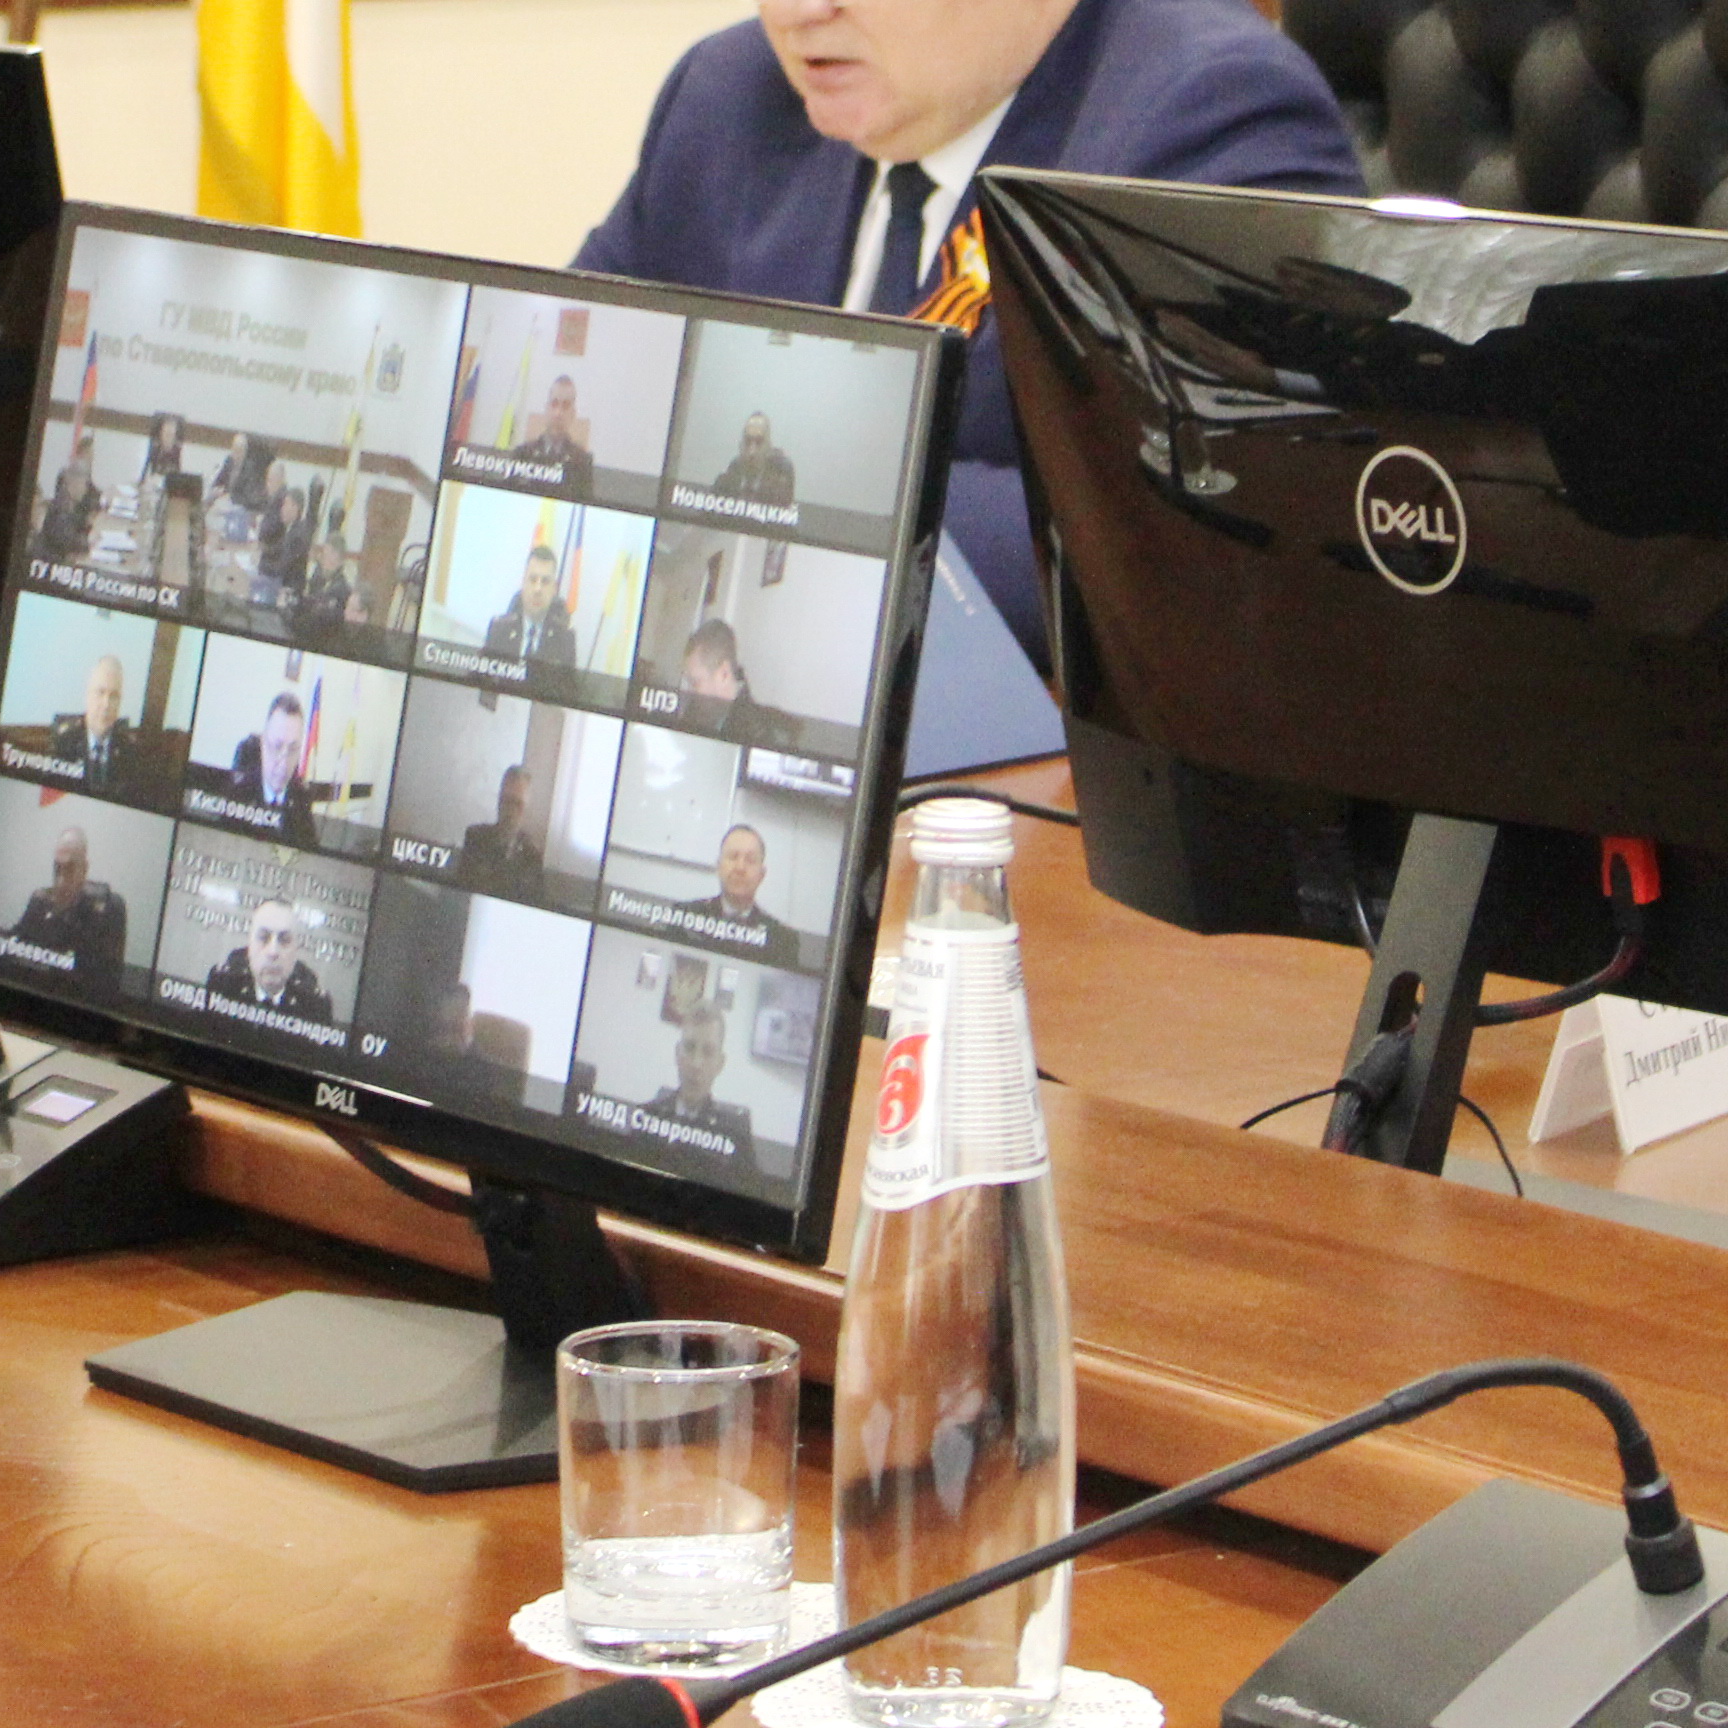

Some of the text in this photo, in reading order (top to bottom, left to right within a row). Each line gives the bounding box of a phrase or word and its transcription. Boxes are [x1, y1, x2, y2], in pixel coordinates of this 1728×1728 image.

[452, 446, 564, 484] Левокумский
[671, 483, 800, 526] Новоселицкий
[1370, 497, 1456, 544] DELL
[29, 559, 50, 579] ГУ
[50, 563, 84, 590] МВД
[85, 571, 138, 598] России
[158, 586, 181, 608] СК
[423, 642, 527, 682] Степновский
[639, 685, 680, 713] ЦПЭ
[1, 741, 86, 779] Труновский
[187, 788, 282, 828] Кисловодск
[608, 889, 768, 948] Минераловодский
[160, 978, 208, 1010] ОМВД
[361, 1033, 388, 1057] ОУ
[1624, 1026, 1703, 1087] Дмитрий
[315, 1081, 359, 1116] DELL
[575, 1090, 736, 1157] УМВД Ставрополь
